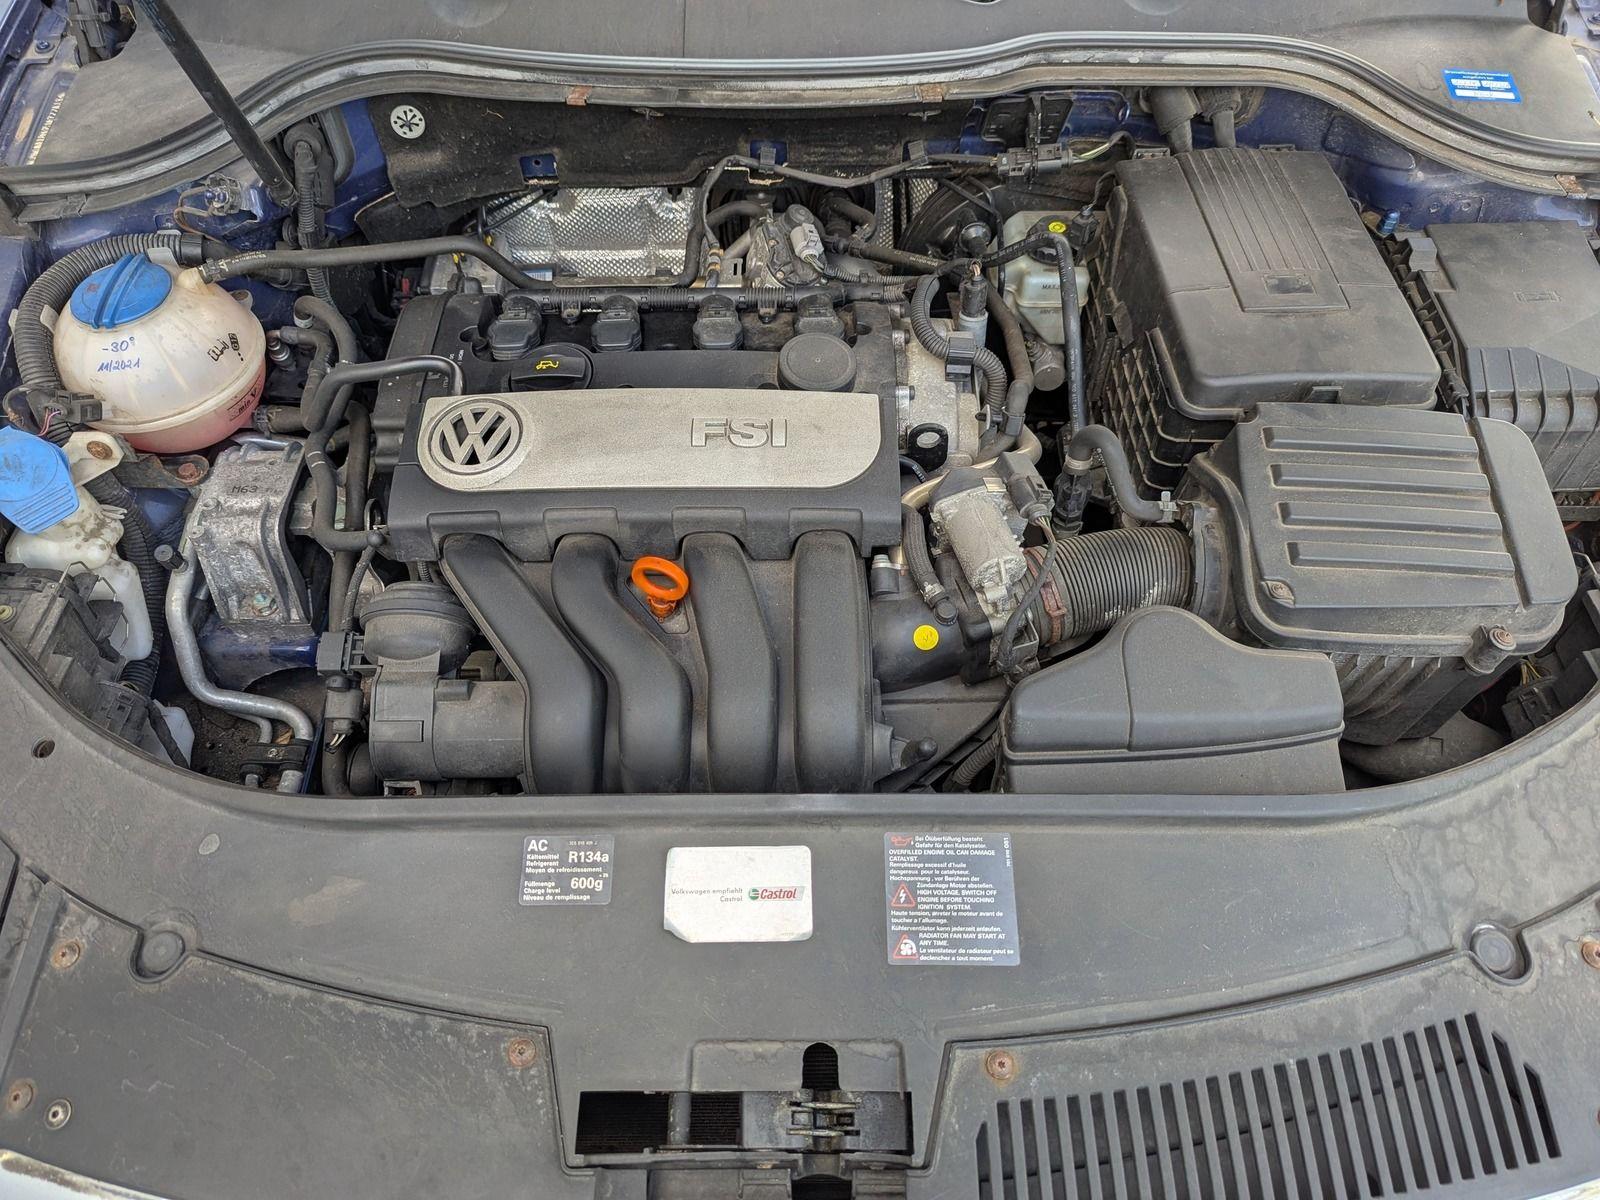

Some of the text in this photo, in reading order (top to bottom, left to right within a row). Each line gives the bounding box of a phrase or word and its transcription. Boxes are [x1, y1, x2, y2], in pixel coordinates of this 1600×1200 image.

[97, 357, 140, 373] 11/2021
[690, 417, 788, 448] FSI
[527, 839, 548, 852] AC
[568, 850, 609, 863] R134a
[570, 876, 603, 891] 600g
[523, 887, 545, 895] Charge
[671, 887, 743, 897] Volkswagen empfiehlt
[760, 888, 797, 900] Castrol
[554, 894, 591, 902] remplissage
